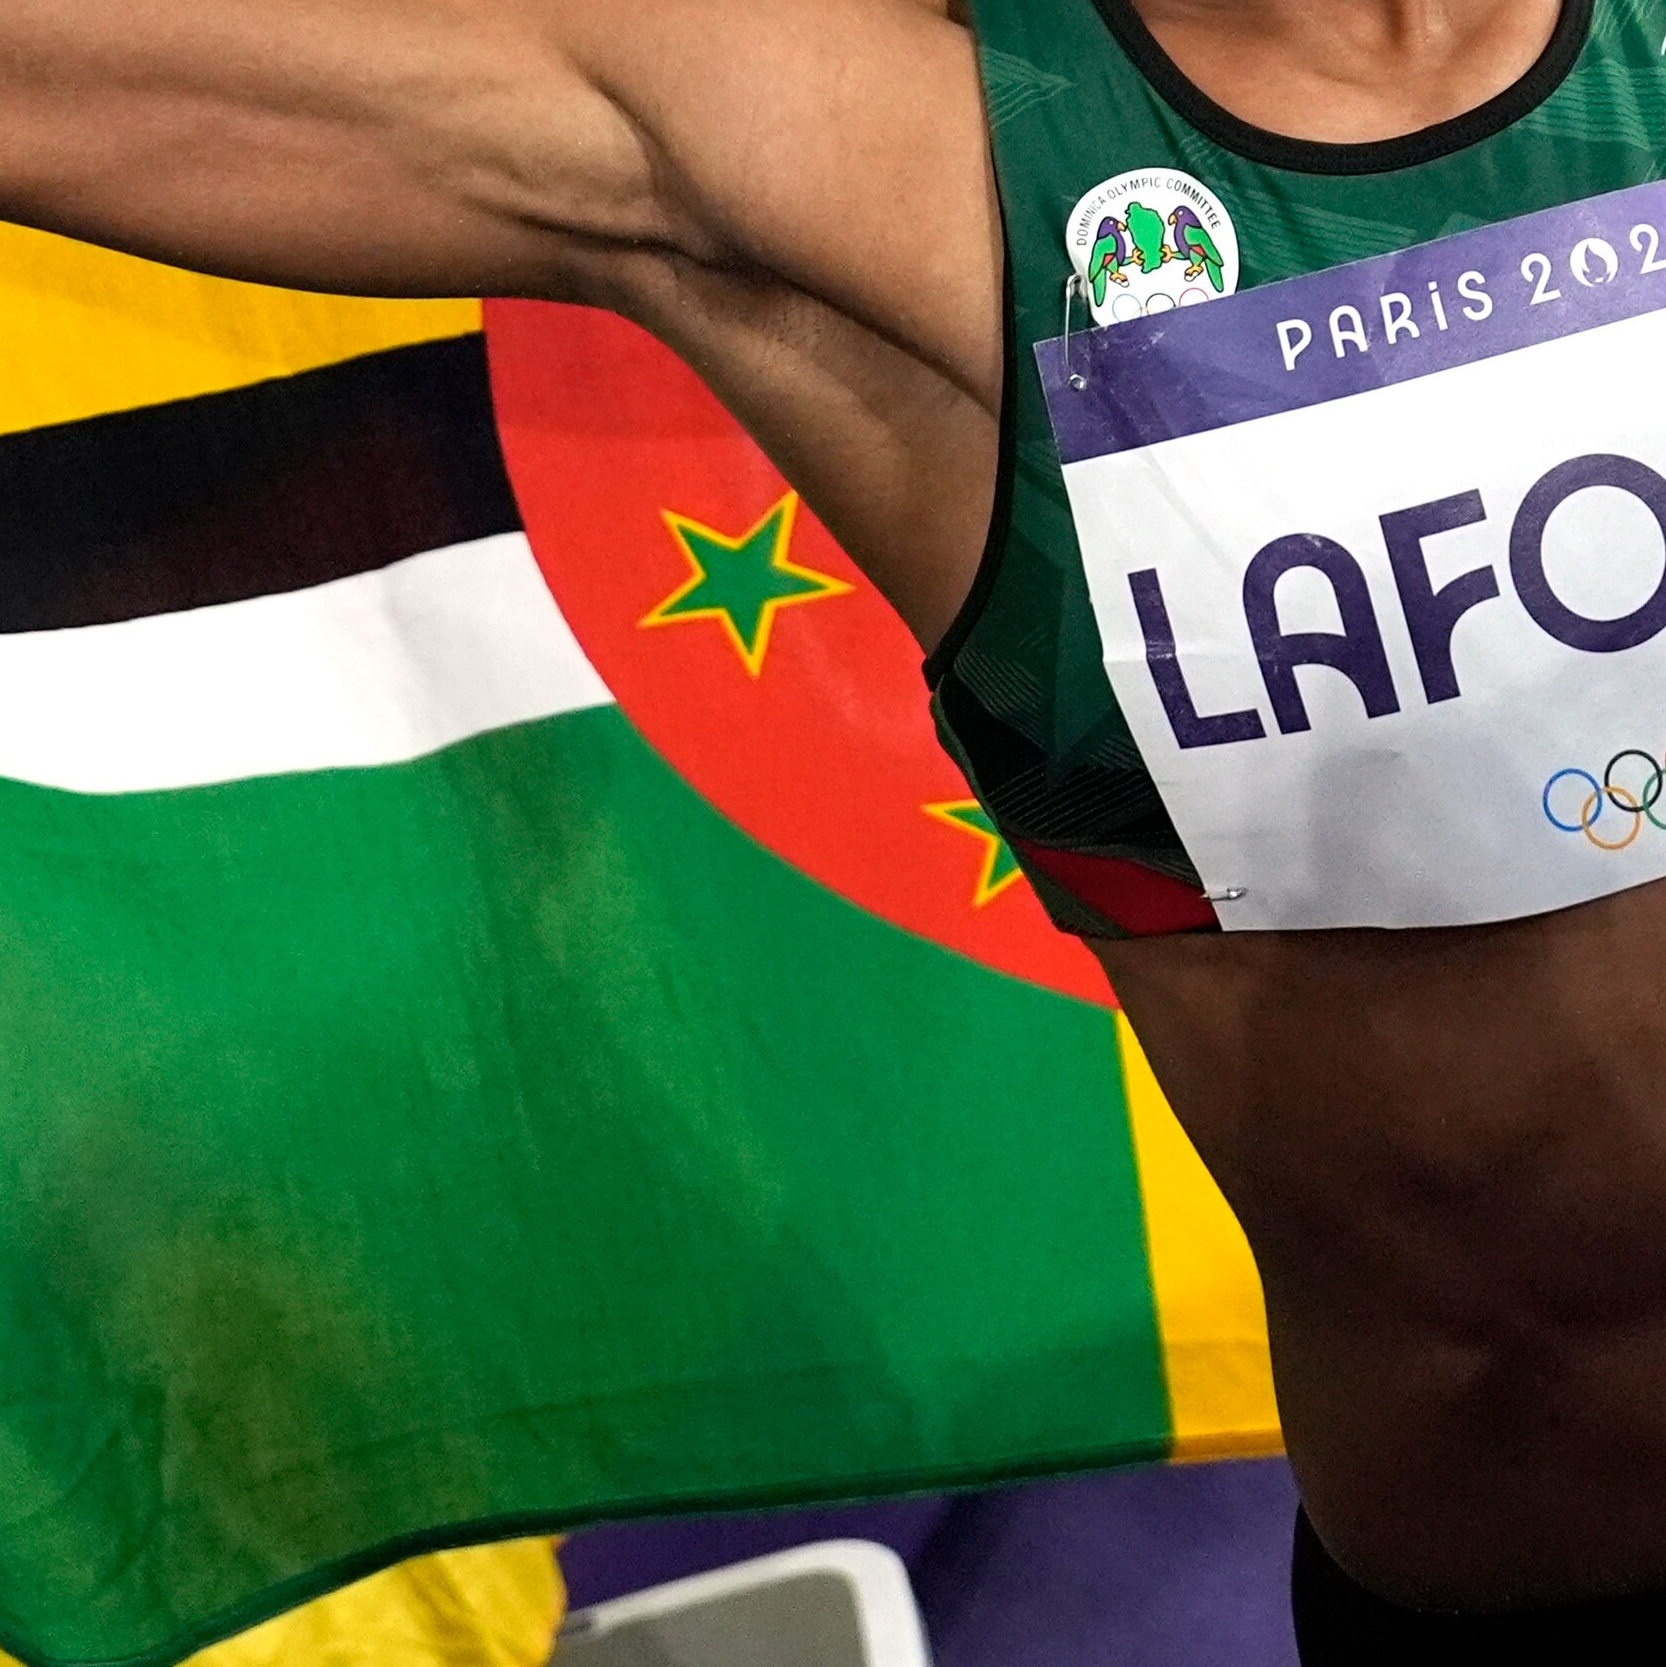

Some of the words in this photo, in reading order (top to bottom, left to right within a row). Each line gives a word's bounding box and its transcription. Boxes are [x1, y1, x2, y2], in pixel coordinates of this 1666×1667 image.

[1076, 196, 1106, 245] DOMINICA
[1107, 178, 1162, 200] OLYMPIC
[1166, 178, 1221, 229] COMMITTEE
[1276, 271, 1494, 371] PARIS
